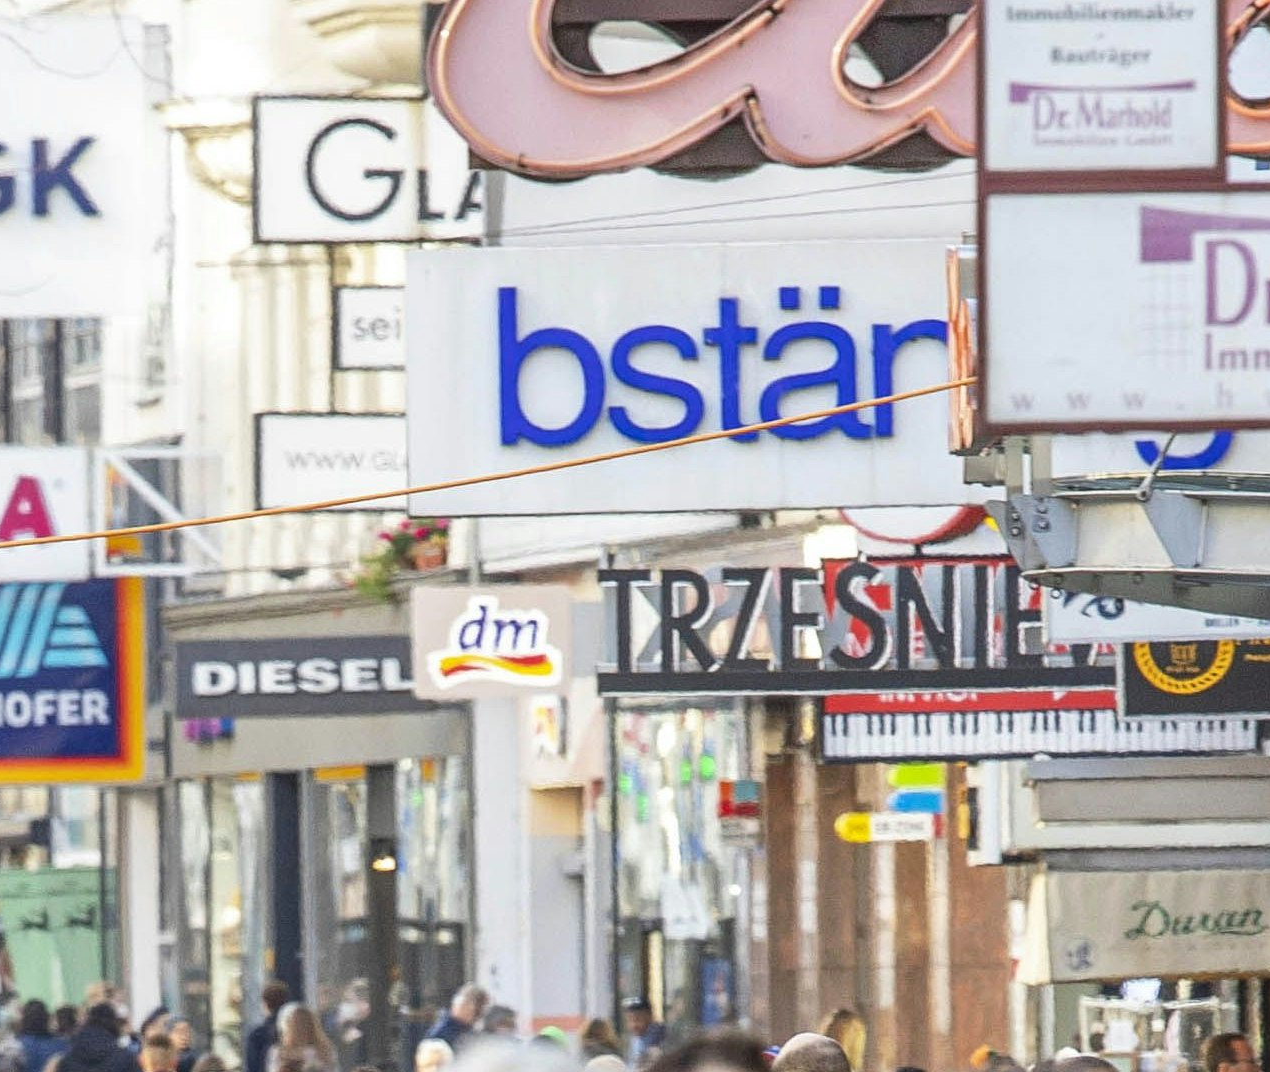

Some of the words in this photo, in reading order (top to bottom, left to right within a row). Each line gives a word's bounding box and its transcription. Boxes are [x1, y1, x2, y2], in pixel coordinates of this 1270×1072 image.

[1006, 3, 1194, 21] Immobilienmakler
[1051, 49, 1151, 66] Bauträger
[1079, 93, 1172, 128] Marhold
[458, 605, 538, 652] dm
[192, 658, 414, 697] DIESEL
